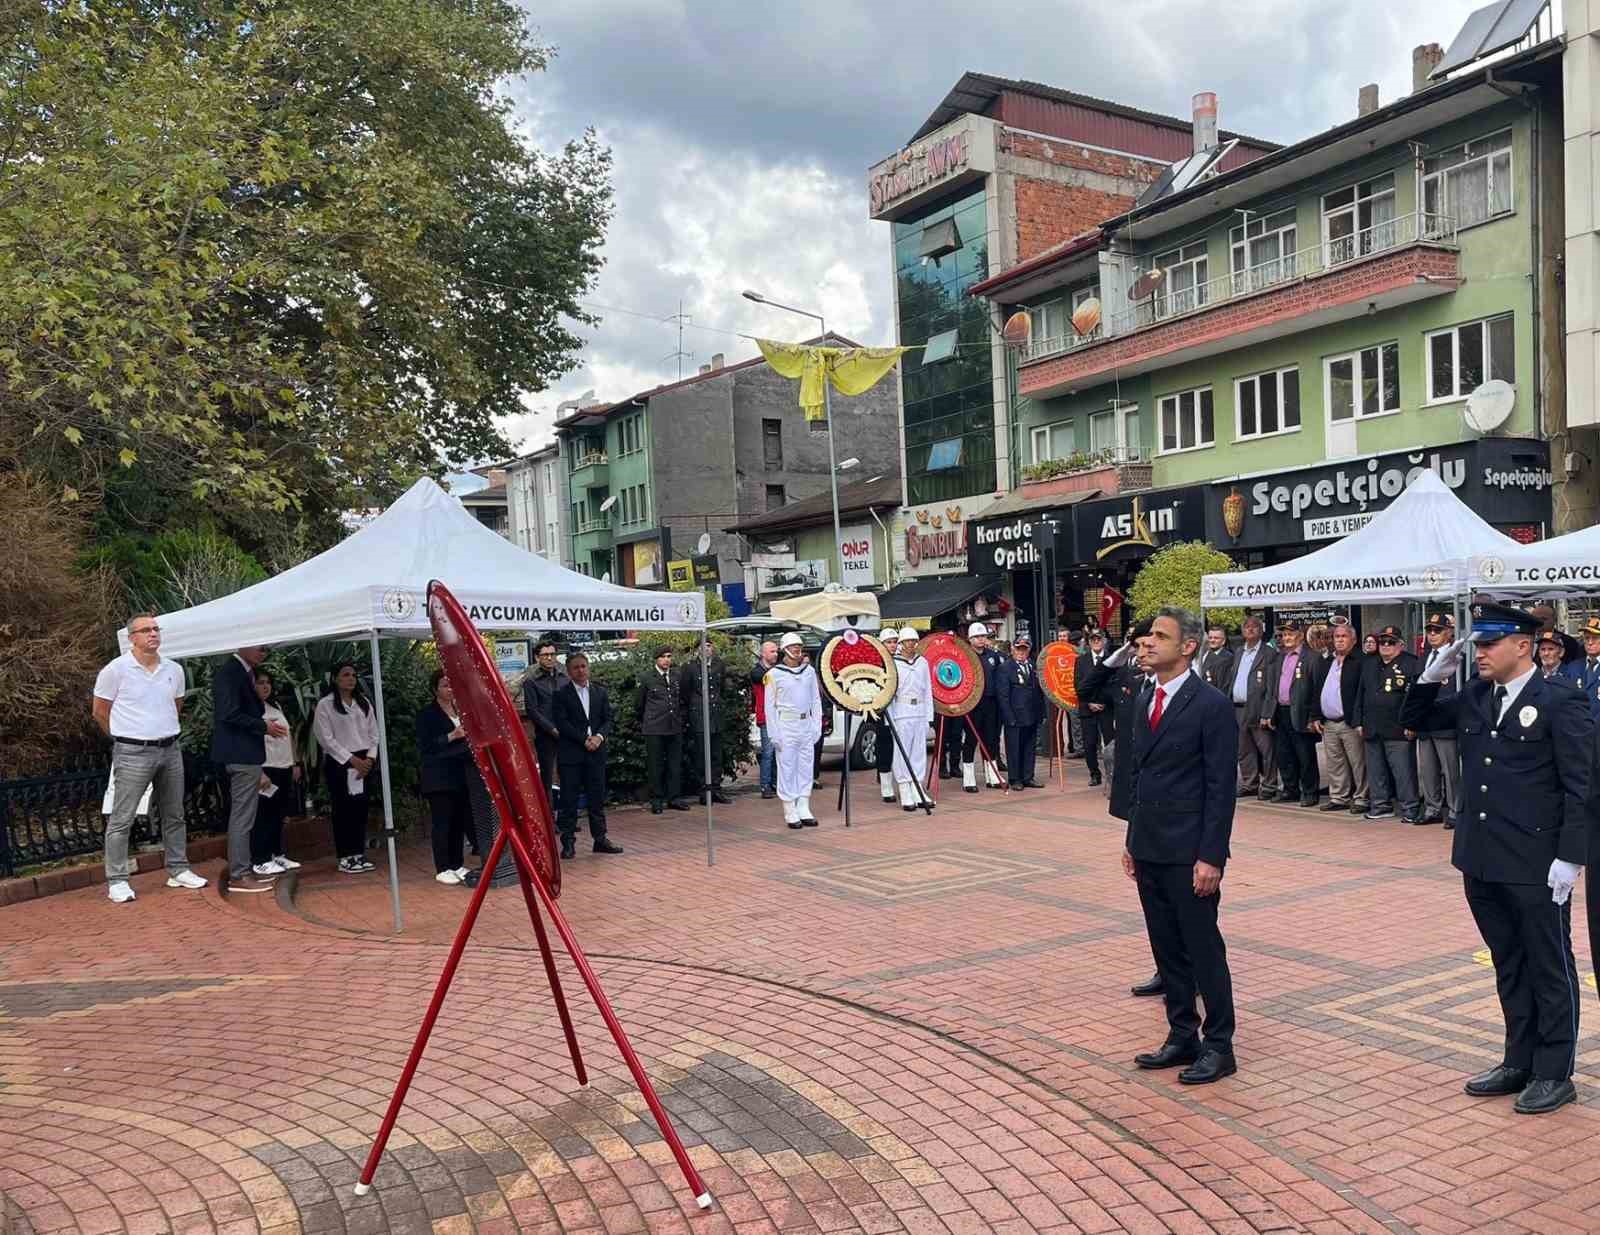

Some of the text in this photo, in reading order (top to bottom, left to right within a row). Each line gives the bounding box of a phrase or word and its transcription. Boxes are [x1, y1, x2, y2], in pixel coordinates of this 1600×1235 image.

[841, 539, 869, 559] ONUR
[844, 560, 869, 570] TEKEL
[1247, 582, 1303, 599] ÇAYCUMA
[463, 604, 541, 621] AYCUMA
